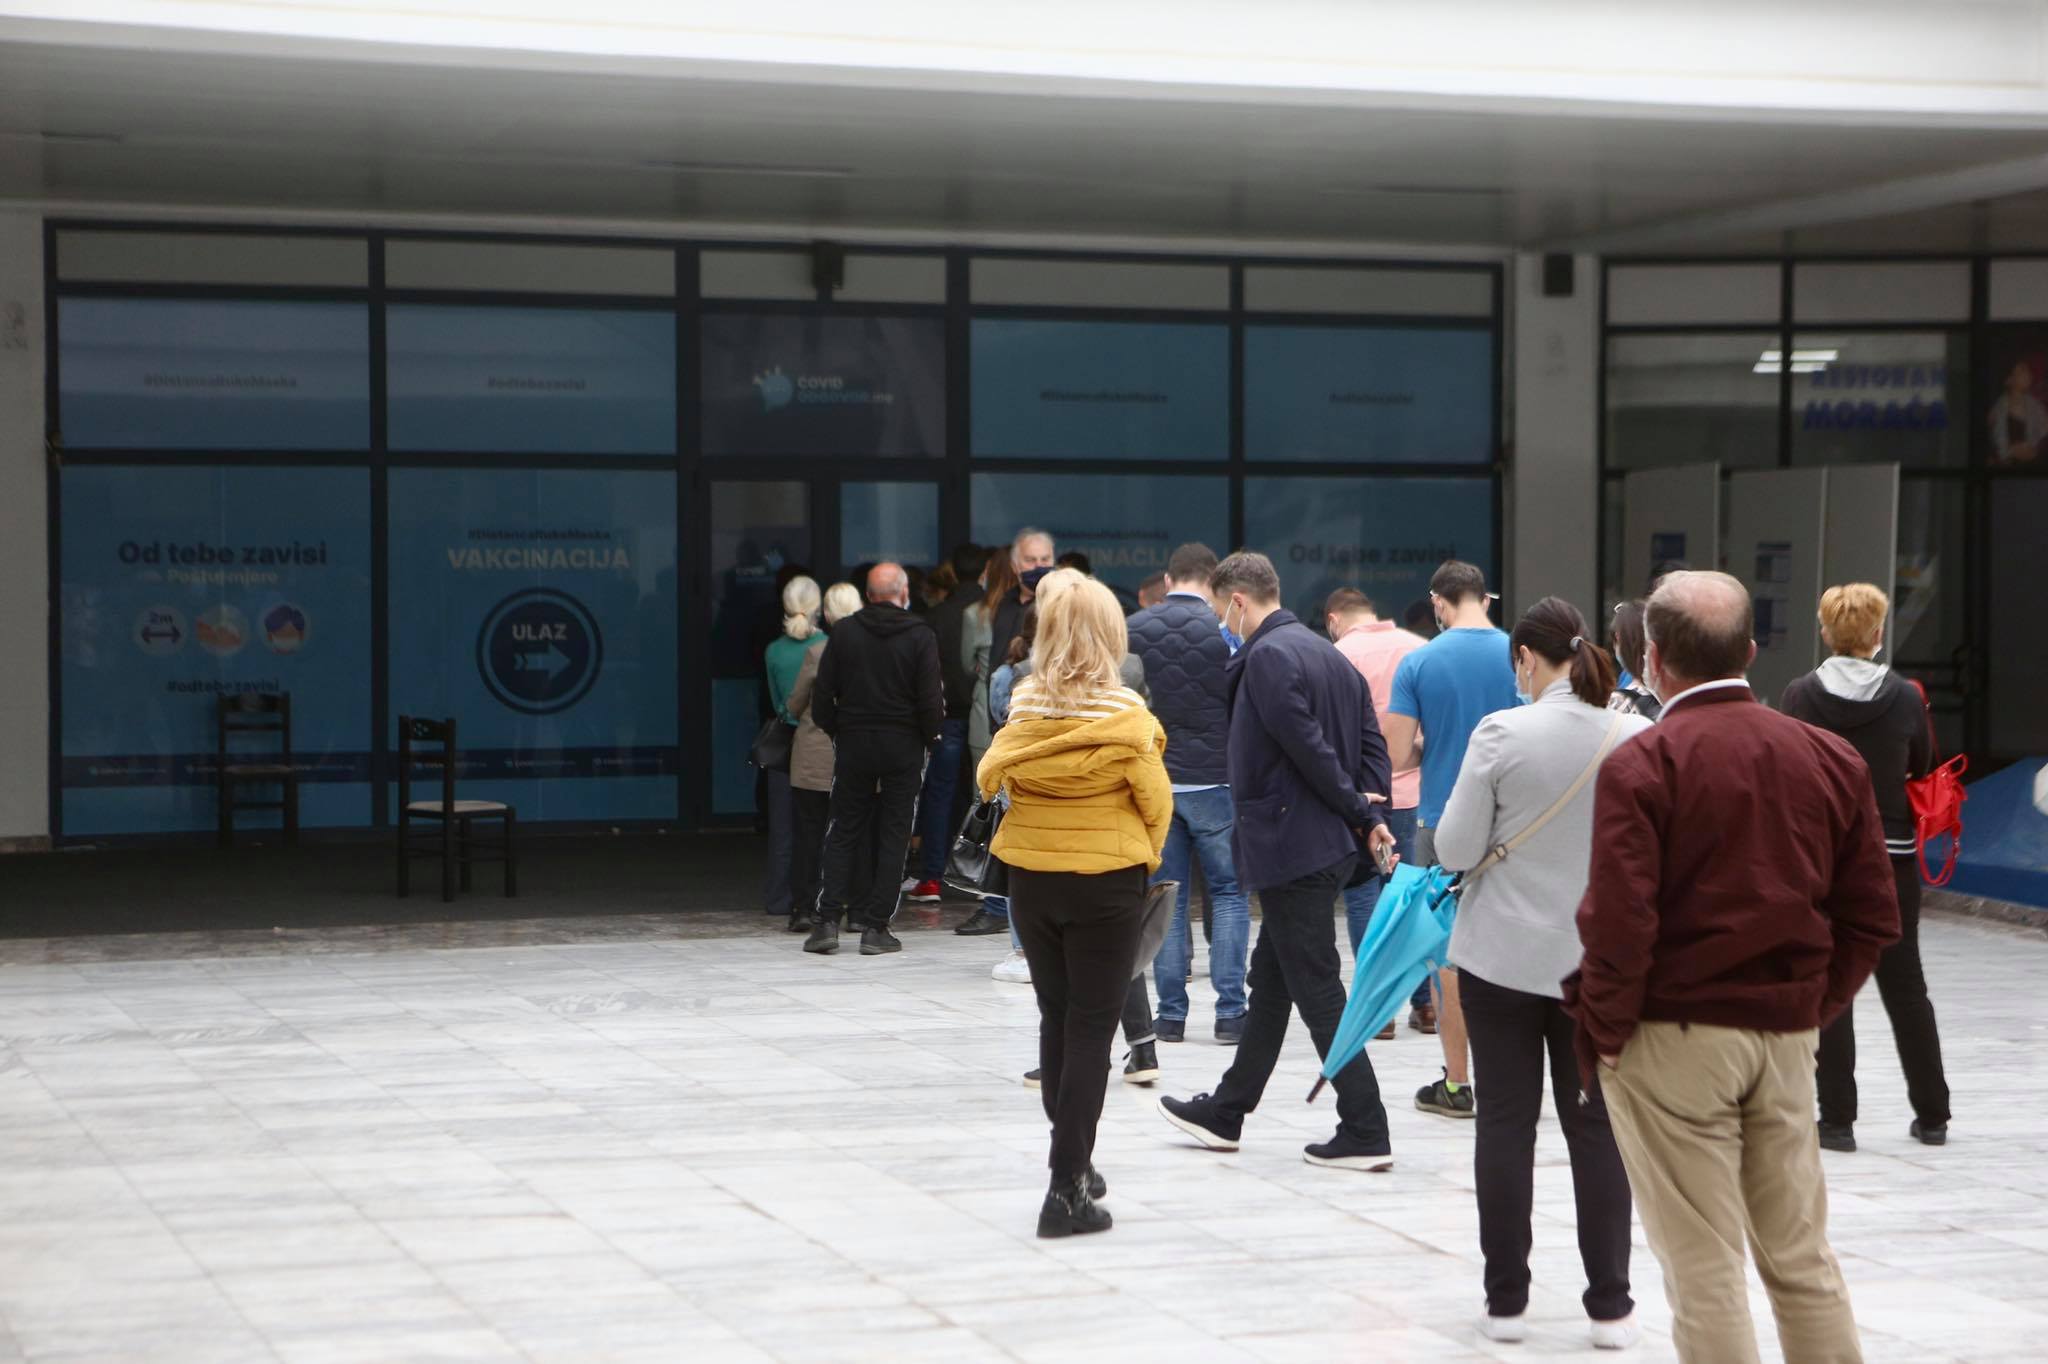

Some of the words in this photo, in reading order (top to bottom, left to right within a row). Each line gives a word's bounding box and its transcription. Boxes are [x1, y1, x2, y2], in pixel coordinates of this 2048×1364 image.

[118, 541, 159, 564] Od
[167, 541, 234, 564] tebe
[239, 540, 325, 564] zavisi
[447, 547, 630, 568] VAKCINACIJA
[1290, 543, 1321, 563] Od
[149, 611, 173, 624] 2m
[511, 623, 567, 641] ULAZ
